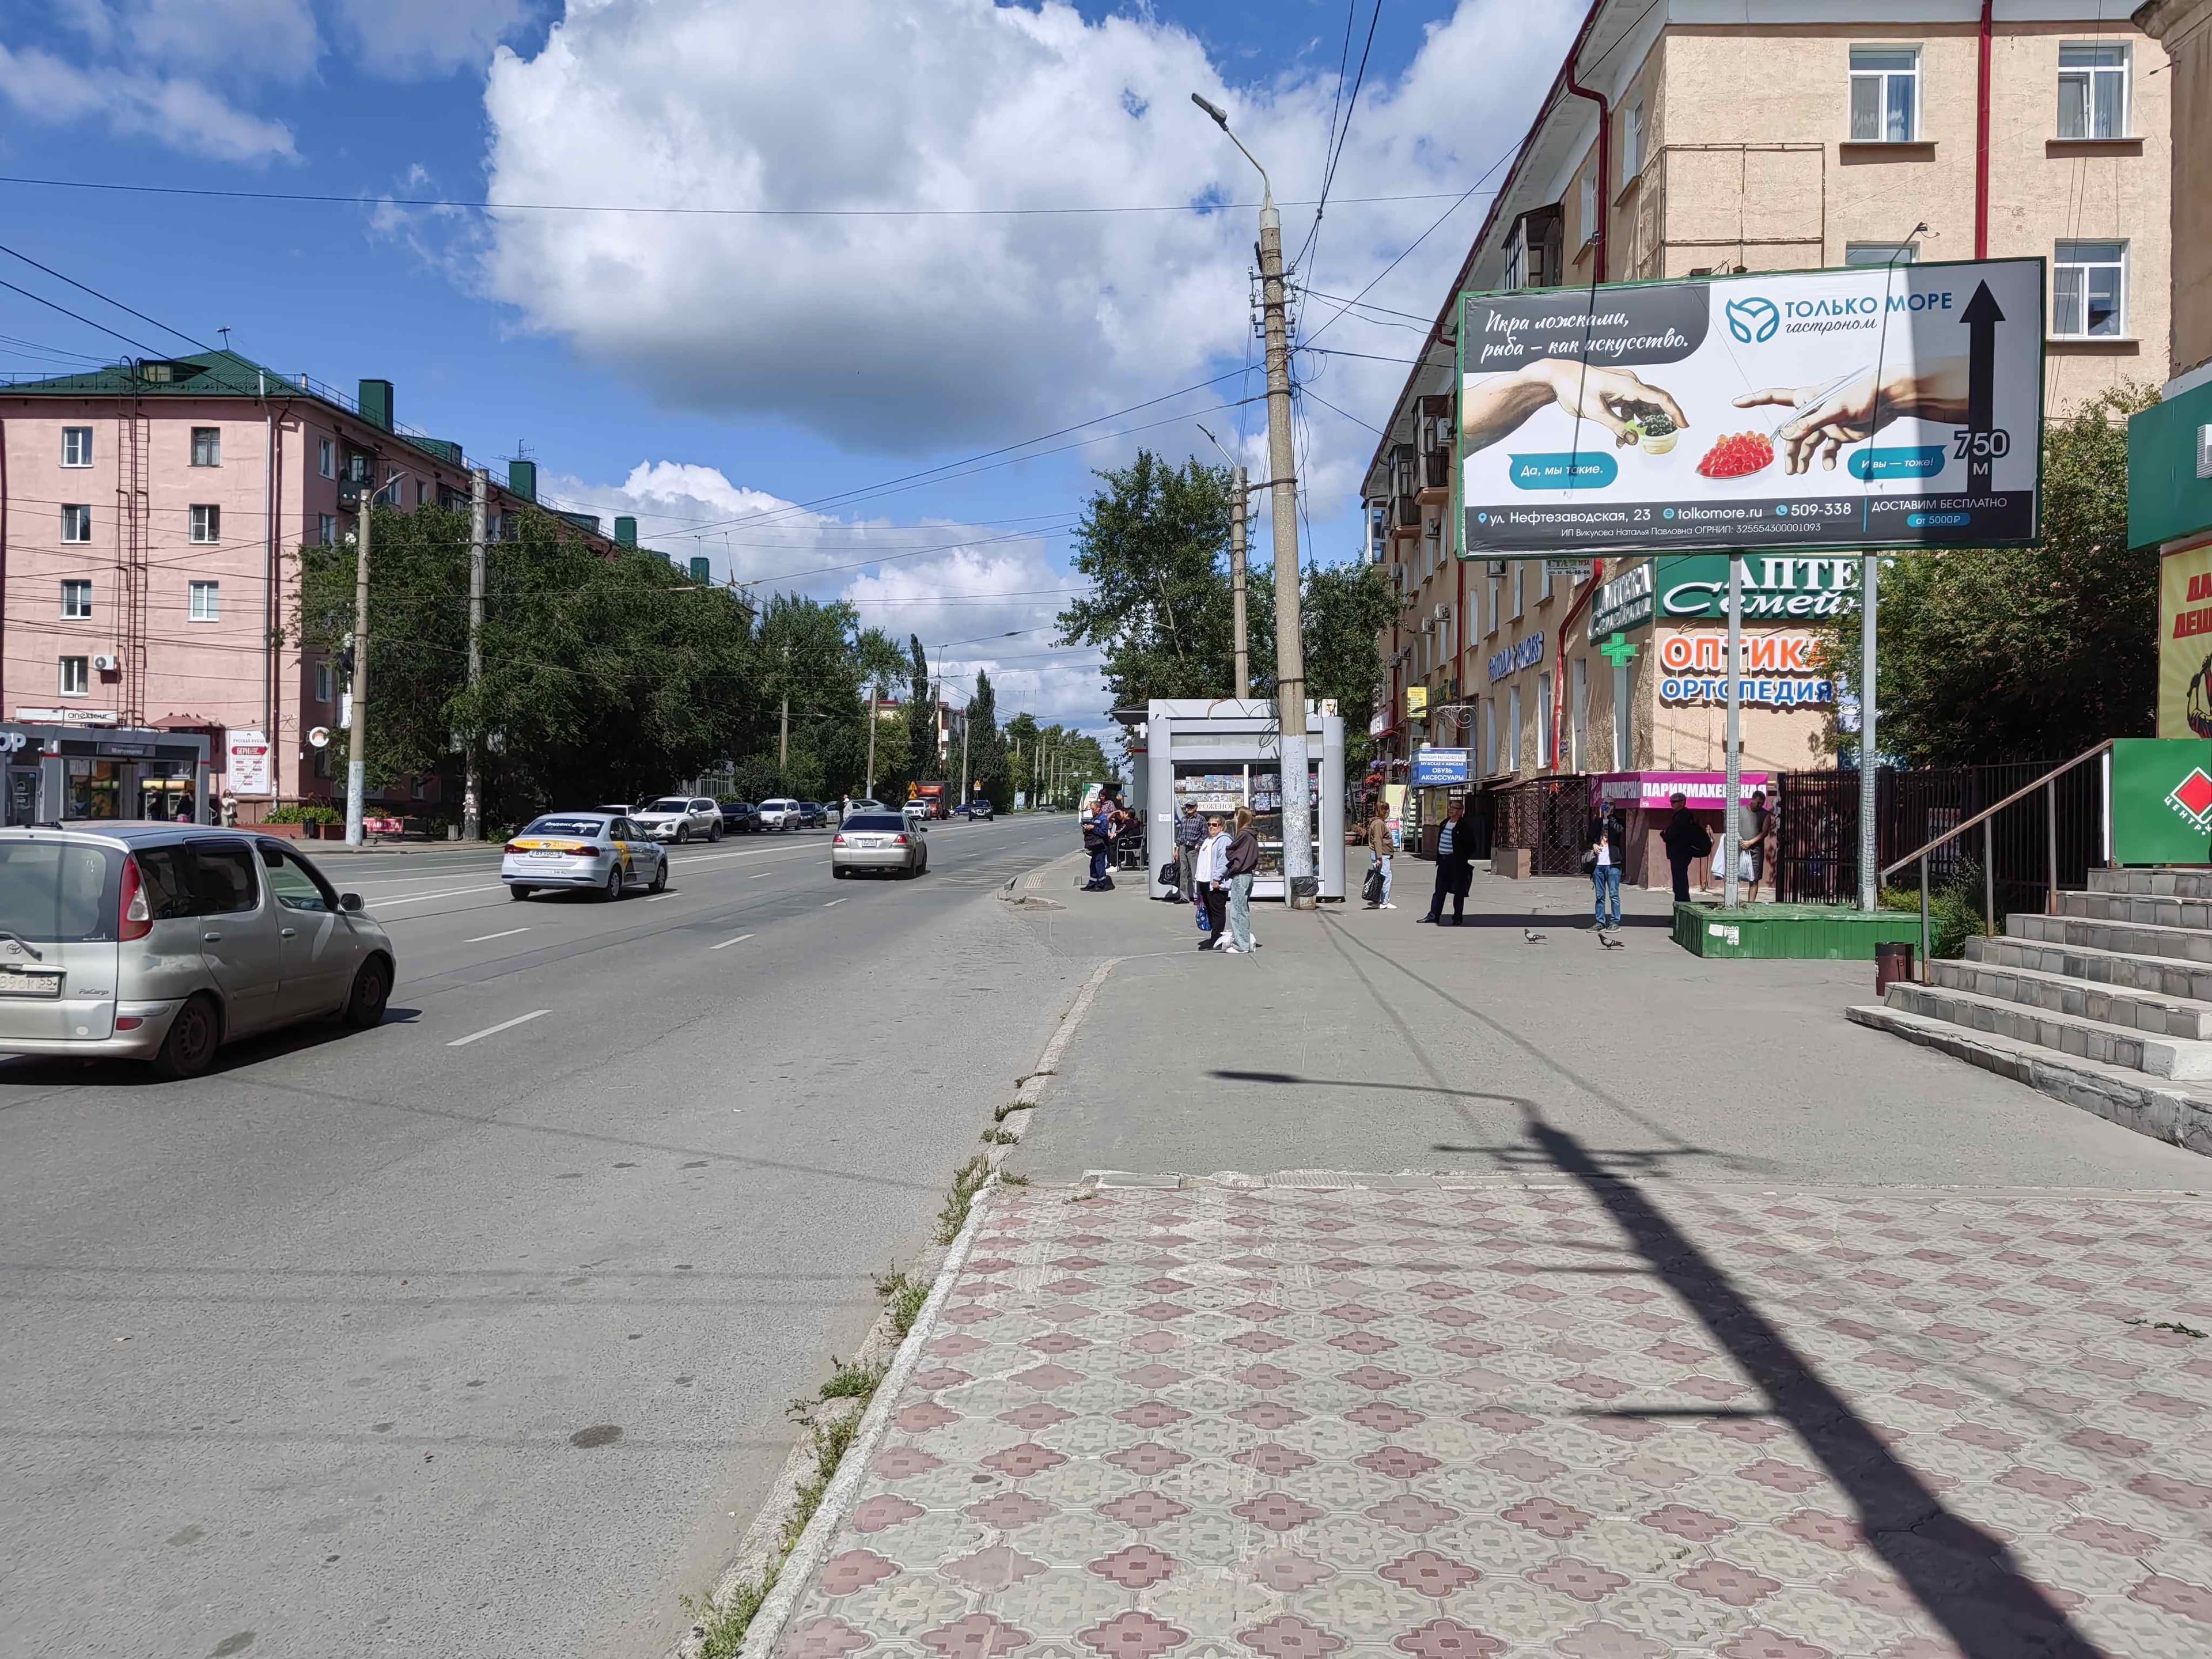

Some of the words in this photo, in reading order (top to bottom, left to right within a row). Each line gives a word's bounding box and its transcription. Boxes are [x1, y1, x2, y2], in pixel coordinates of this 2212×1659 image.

[1785, 297, 1878, 318] ТОЛЬКО
[1885, 292, 1952, 313] МОРЕ
[1485, 309, 1528, 337] Икра
[1535, 313, 1630, 328] ложками,
[1785, 319, 1877, 336] гастроном
[1480, 336, 1524, 364] рыба
[1548, 342, 1579, 354] как
[1585, 327, 1689, 358] искусство.
[1955, 430, 2009, 459] 750
[1520, 465, 1541, 478] Да,
[1544, 466, 1562, 475] мы
[1566, 465, 1603, 475] такие.
[1861, 460, 1869, 469] И
[1904, 457, 1934, 467] тоже!
[1677, 506, 1763, 519] tolkomore.ru
[1790, 502, 1852, 516] 509-338
[1872, 499, 1936, 513] ДОСТАВИМ
[1940, 497, 2008, 509] БЕСПЛАТНО
[1490, 514, 1505, 527] ул.
[1510, 510, 1628, 526] Нефтезаводская,
[1634, 509, 1651, 521] 23
[1561, 528, 1574, 537] ИП
[1576, 529, 1613, 538] Викулова
[1616, 528, 1649, 536] Наталья
[1652, 527, 1692, 535] Павловна
[1694, 525, 1733, 535] ОГРНИП:
[1643, 782, 1767, 799] ПАРИКМАХЕКАЯ
